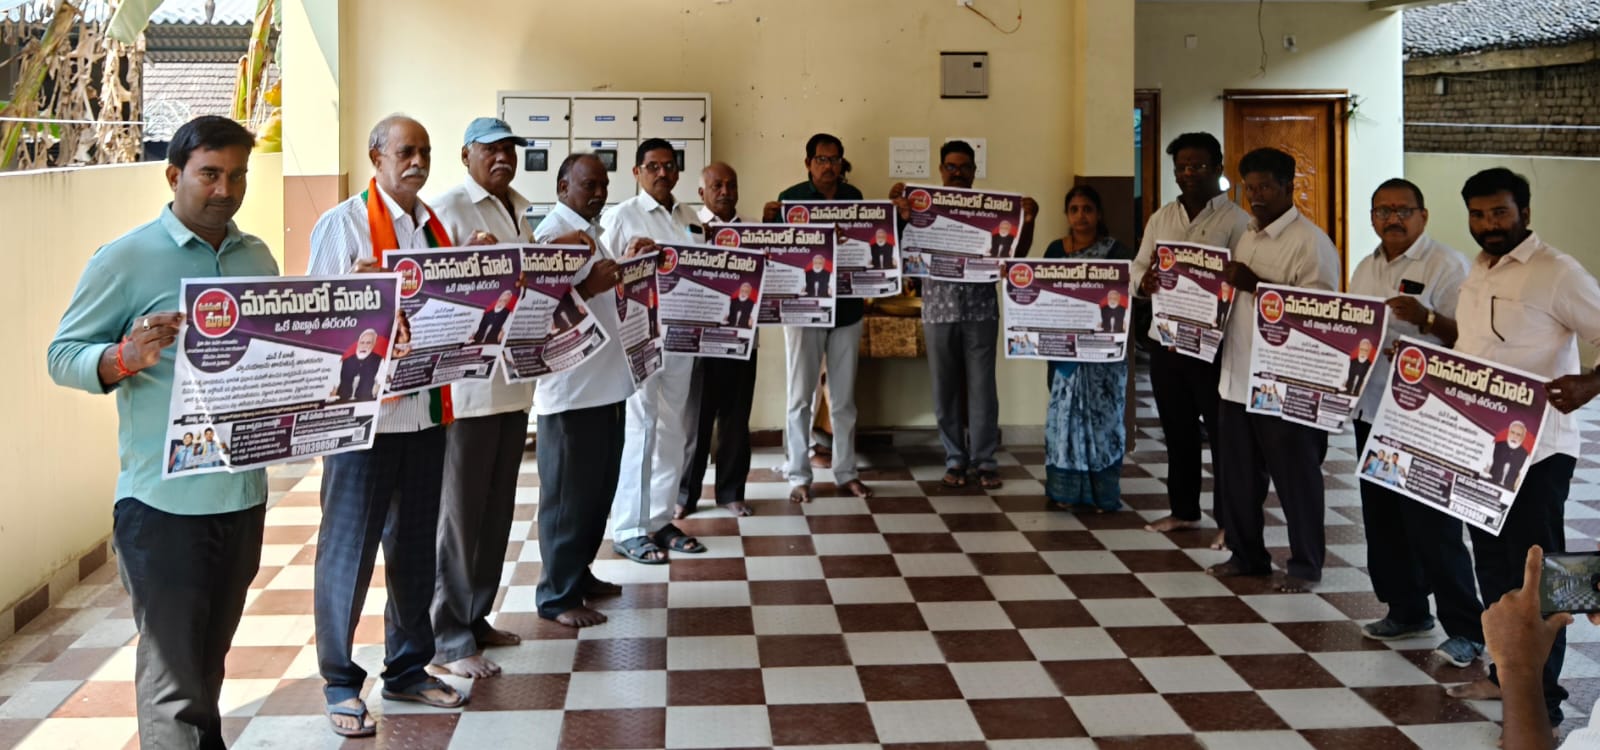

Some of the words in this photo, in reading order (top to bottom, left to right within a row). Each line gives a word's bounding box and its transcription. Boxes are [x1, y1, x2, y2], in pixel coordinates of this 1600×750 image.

[810, 204, 858, 219] మనసులో
[859, 206, 886, 219] మాట
[932, 192, 985, 209] మనసులో
[984, 197, 1013, 211] మాట
[741, 228, 795, 244] మనసులో
[795, 230, 825, 244] మాట
[423, 253, 481, 280] మనసులో
[481, 254, 513, 276] మాట
[679, 250, 729, 268] మనసులో
[727, 255, 757, 272] మాట
[1204, 253, 1223, 271] మాట
[1034, 264, 1088, 279] మనసులో
[1088, 265, 1119, 280] మాట
[240, 282, 331, 316] మనసులో
[333, 285, 381, 312] మాట
[1285, 296, 1342, 320] మనసులో
[1341, 303, 1375, 325] మాట
[274, 320, 290, 332] ఒక
[291, 320, 320, 335] విజ్ఞాన
[321, 317, 358, 330] తరంగం
[1427, 355, 1493, 393] మనసులో
[1489, 375, 1534, 406] మాట
[1445, 387, 1456, 395] ఒక
[1476, 395, 1508, 414] తరంగం
